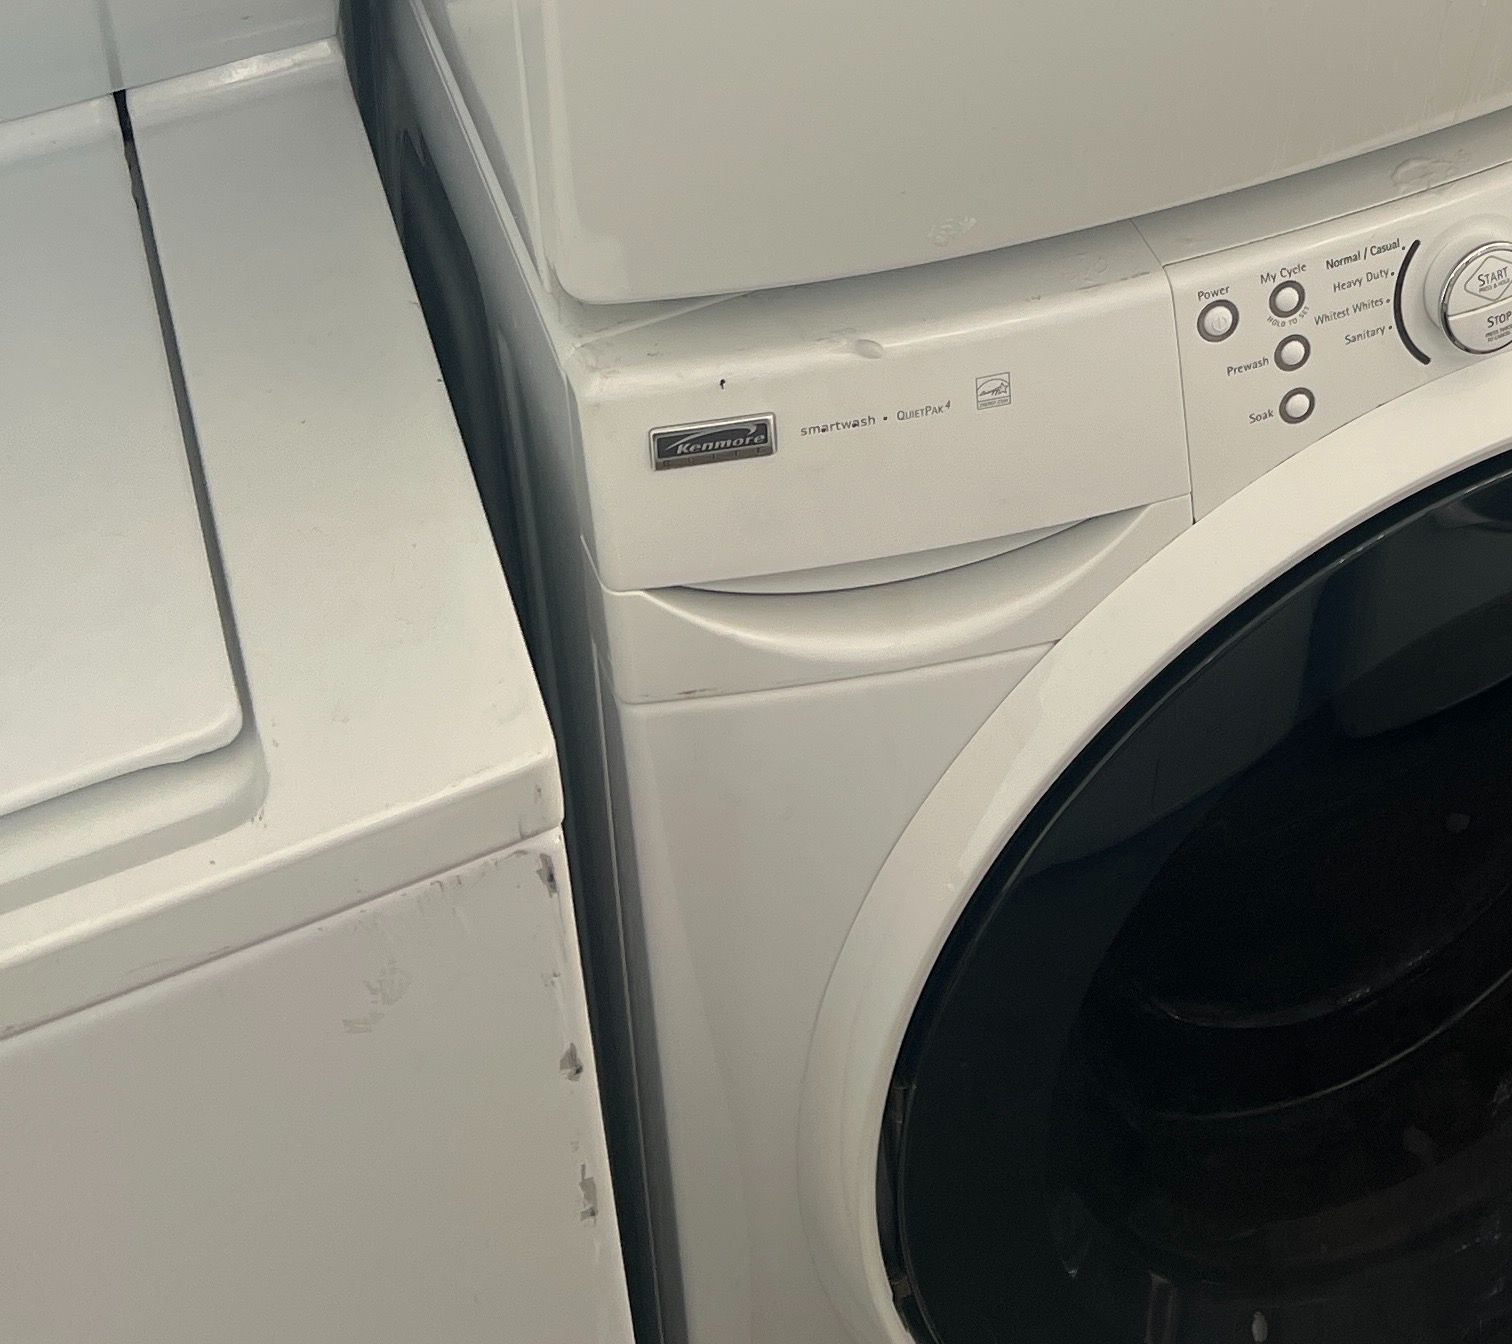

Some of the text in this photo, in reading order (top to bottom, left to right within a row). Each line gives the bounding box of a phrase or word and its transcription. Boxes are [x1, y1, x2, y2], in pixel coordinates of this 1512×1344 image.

[1326, 251, 1361, 270] Normal
[1370, 238, 1400, 256] Casual
[1260, 263, 1307, 284] My Cycle
[1333, 268, 1389, 292] Heavy Duty
[1478, 266, 1508, 287] START
[1197, 286, 1230, 301] Power
[1314, 297, 1384, 326] Whitest Whites
[1487, 311, 1512, 328] STOP
[1345, 326, 1385, 345] Sanitary
[1226, 357, 1269, 376] Prewash
[800, 415, 876, 436] smartwash
[1249, 409, 1274, 424] Soak
[676, 433, 764, 454] Kenmore
